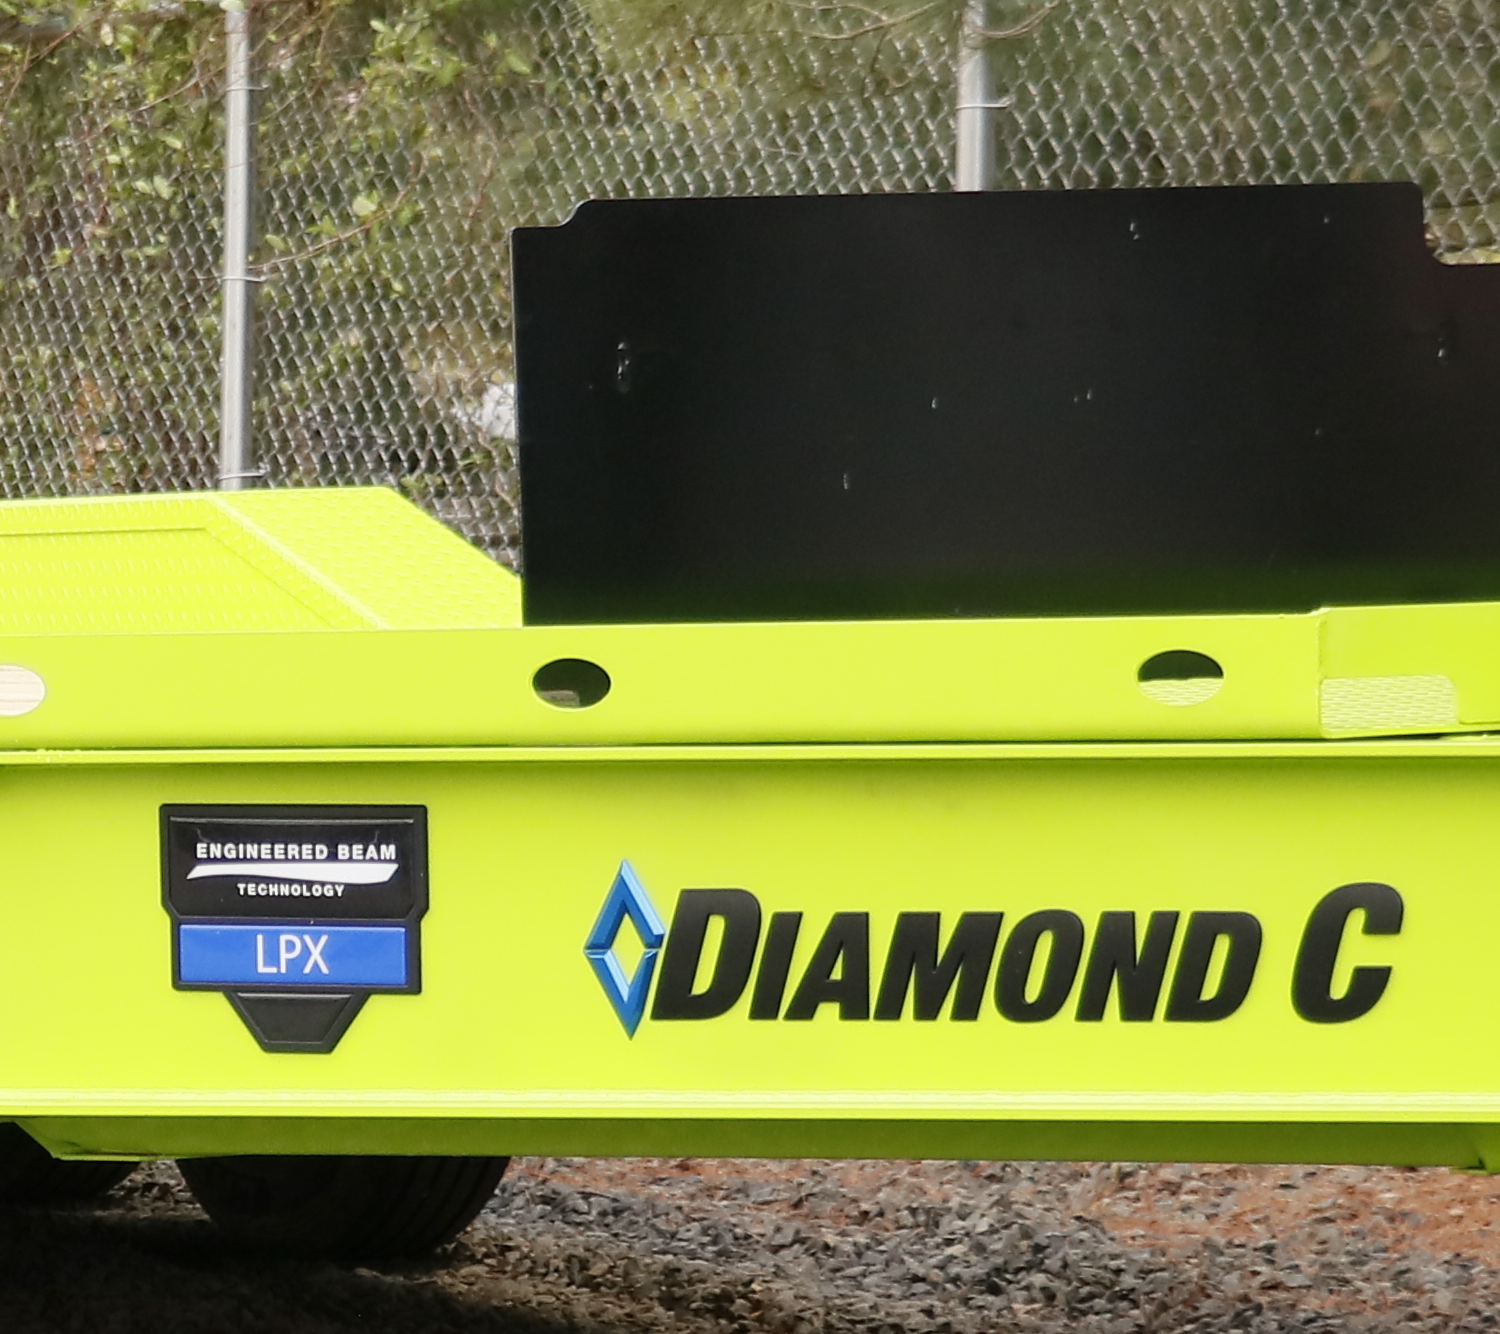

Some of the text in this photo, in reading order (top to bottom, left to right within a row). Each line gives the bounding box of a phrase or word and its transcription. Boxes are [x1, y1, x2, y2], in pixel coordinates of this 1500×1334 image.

[196, 843, 396, 860] ENGINEERED BEAM
[237, 883, 345, 897] TECHNOLOGY
[256, 934, 330, 974] LPX
[650, 882, 1404, 1024] DIAMOND C
